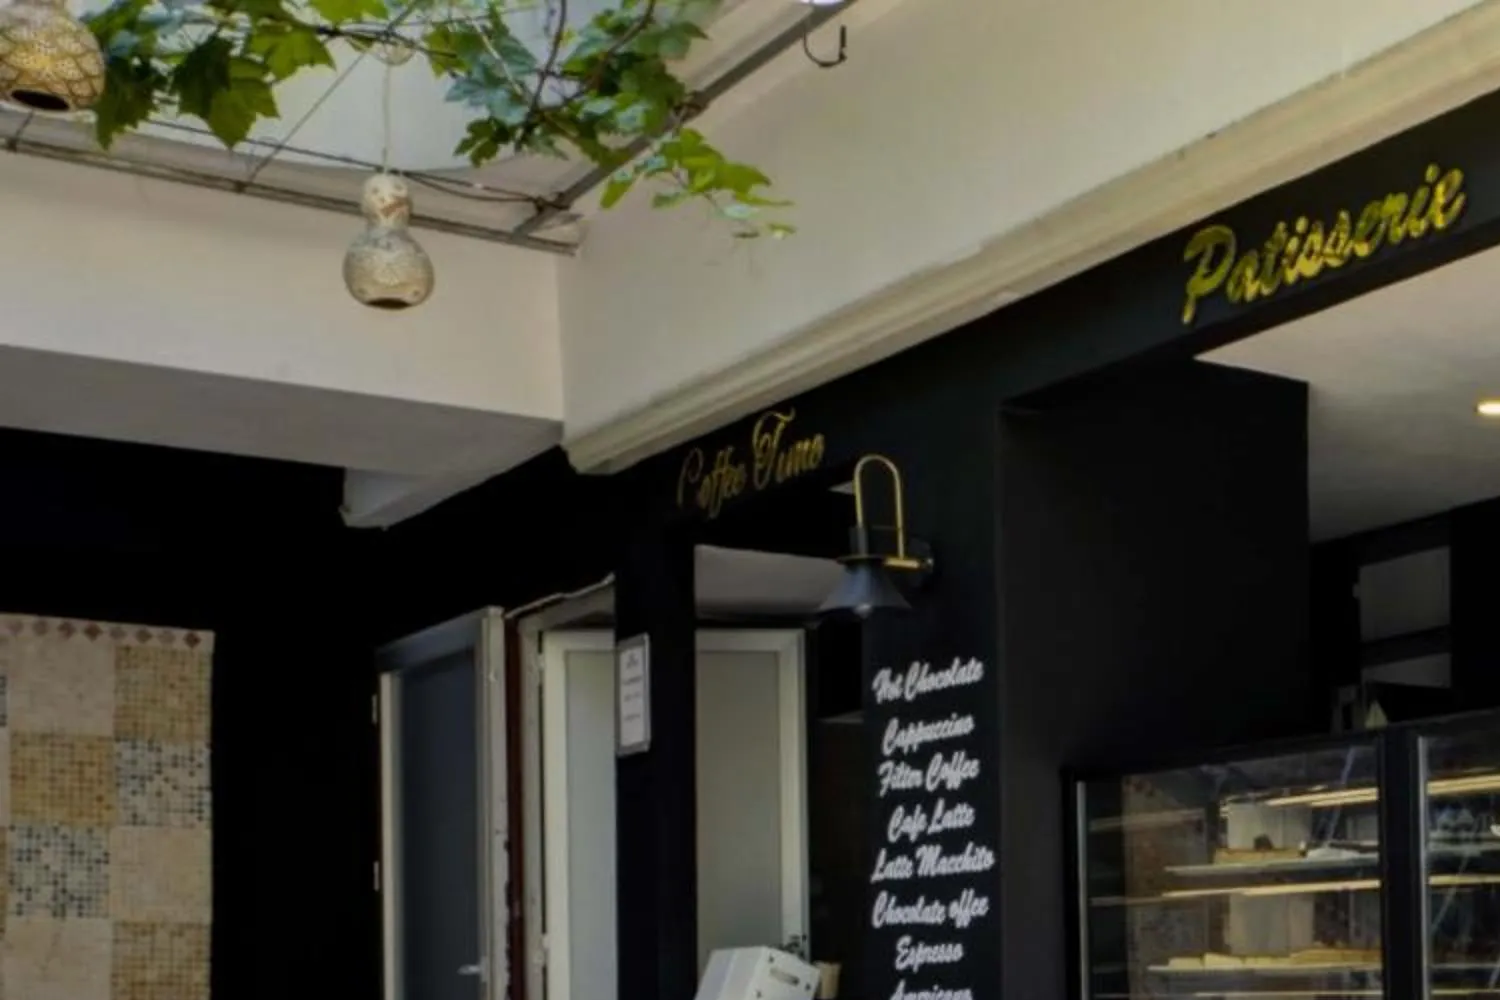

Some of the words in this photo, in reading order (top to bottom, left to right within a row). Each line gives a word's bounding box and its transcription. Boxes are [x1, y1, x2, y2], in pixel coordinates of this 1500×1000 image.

[1182, 162, 1466, 325] Patisserie
[871, 667, 903, 704] Hot
[904, 657, 984, 701] Chocolate
[881, 712, 975, 756] Cappuccino
[924, 750, 981, 792] Coffee
[927, 797, 976, 836] Latte
[872, 890, 946, 929] Chocolate
